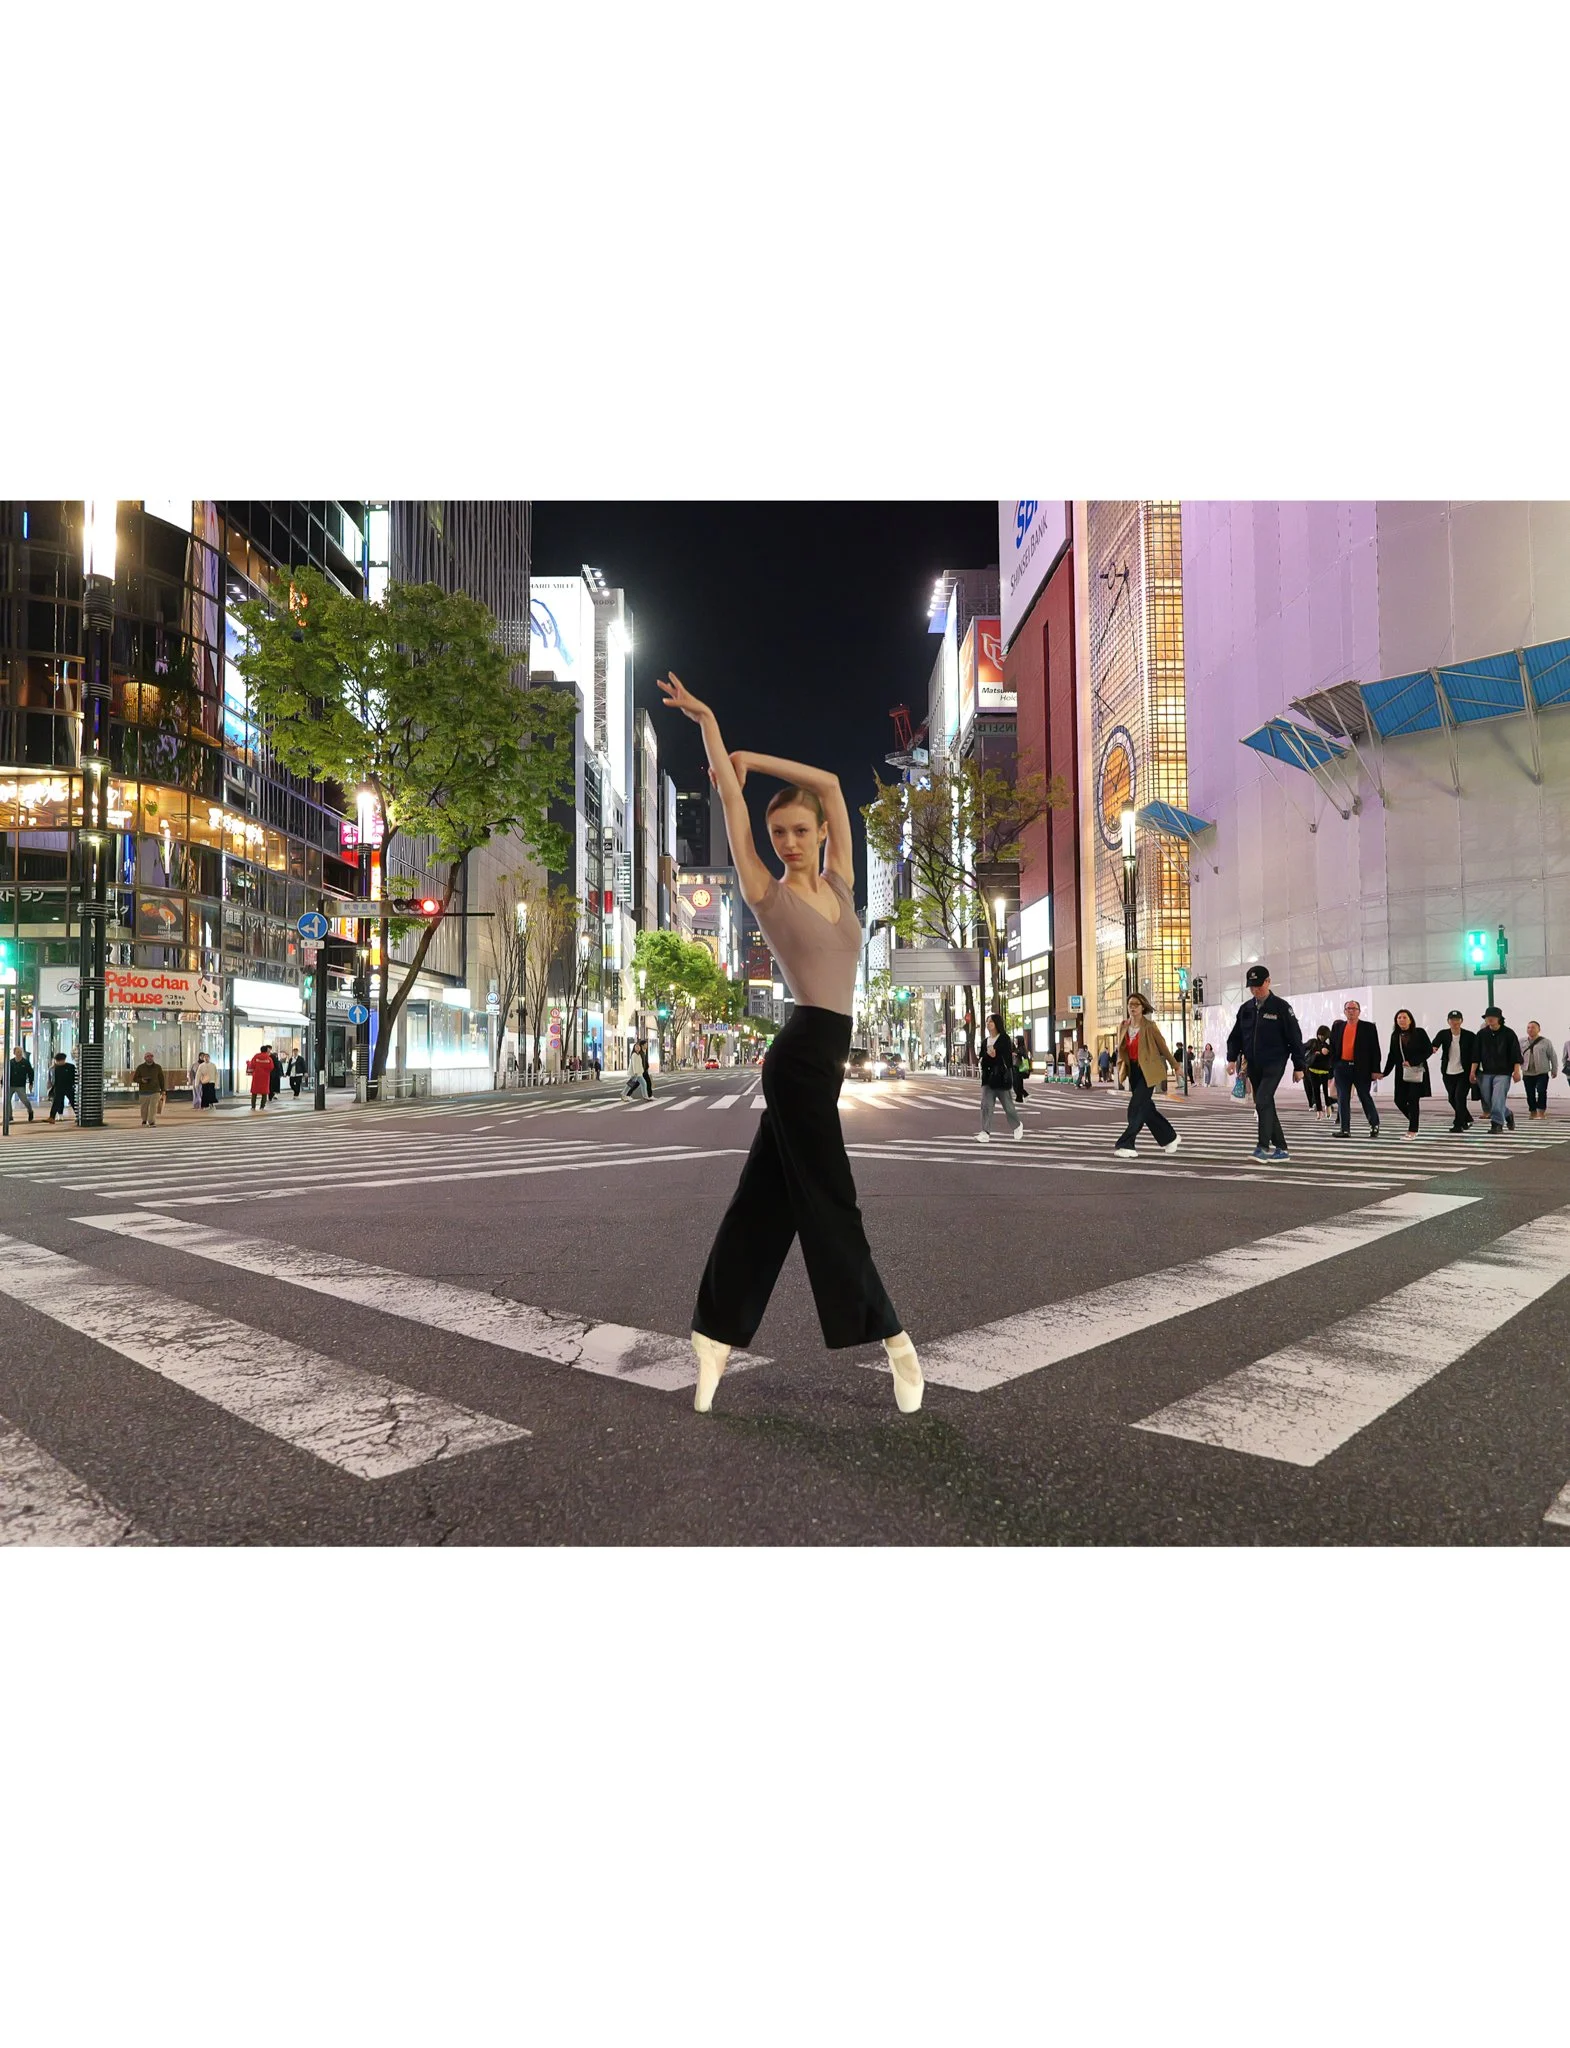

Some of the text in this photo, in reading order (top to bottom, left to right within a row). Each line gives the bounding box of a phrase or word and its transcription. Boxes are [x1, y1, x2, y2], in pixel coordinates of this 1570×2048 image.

[1016, 501, 1038, 549] SB
[1010, 509, 1048, 597] SHINSEI BANK
[105, 971, 189, 991] Peko chan
[109, 988, 163, 1005] House
